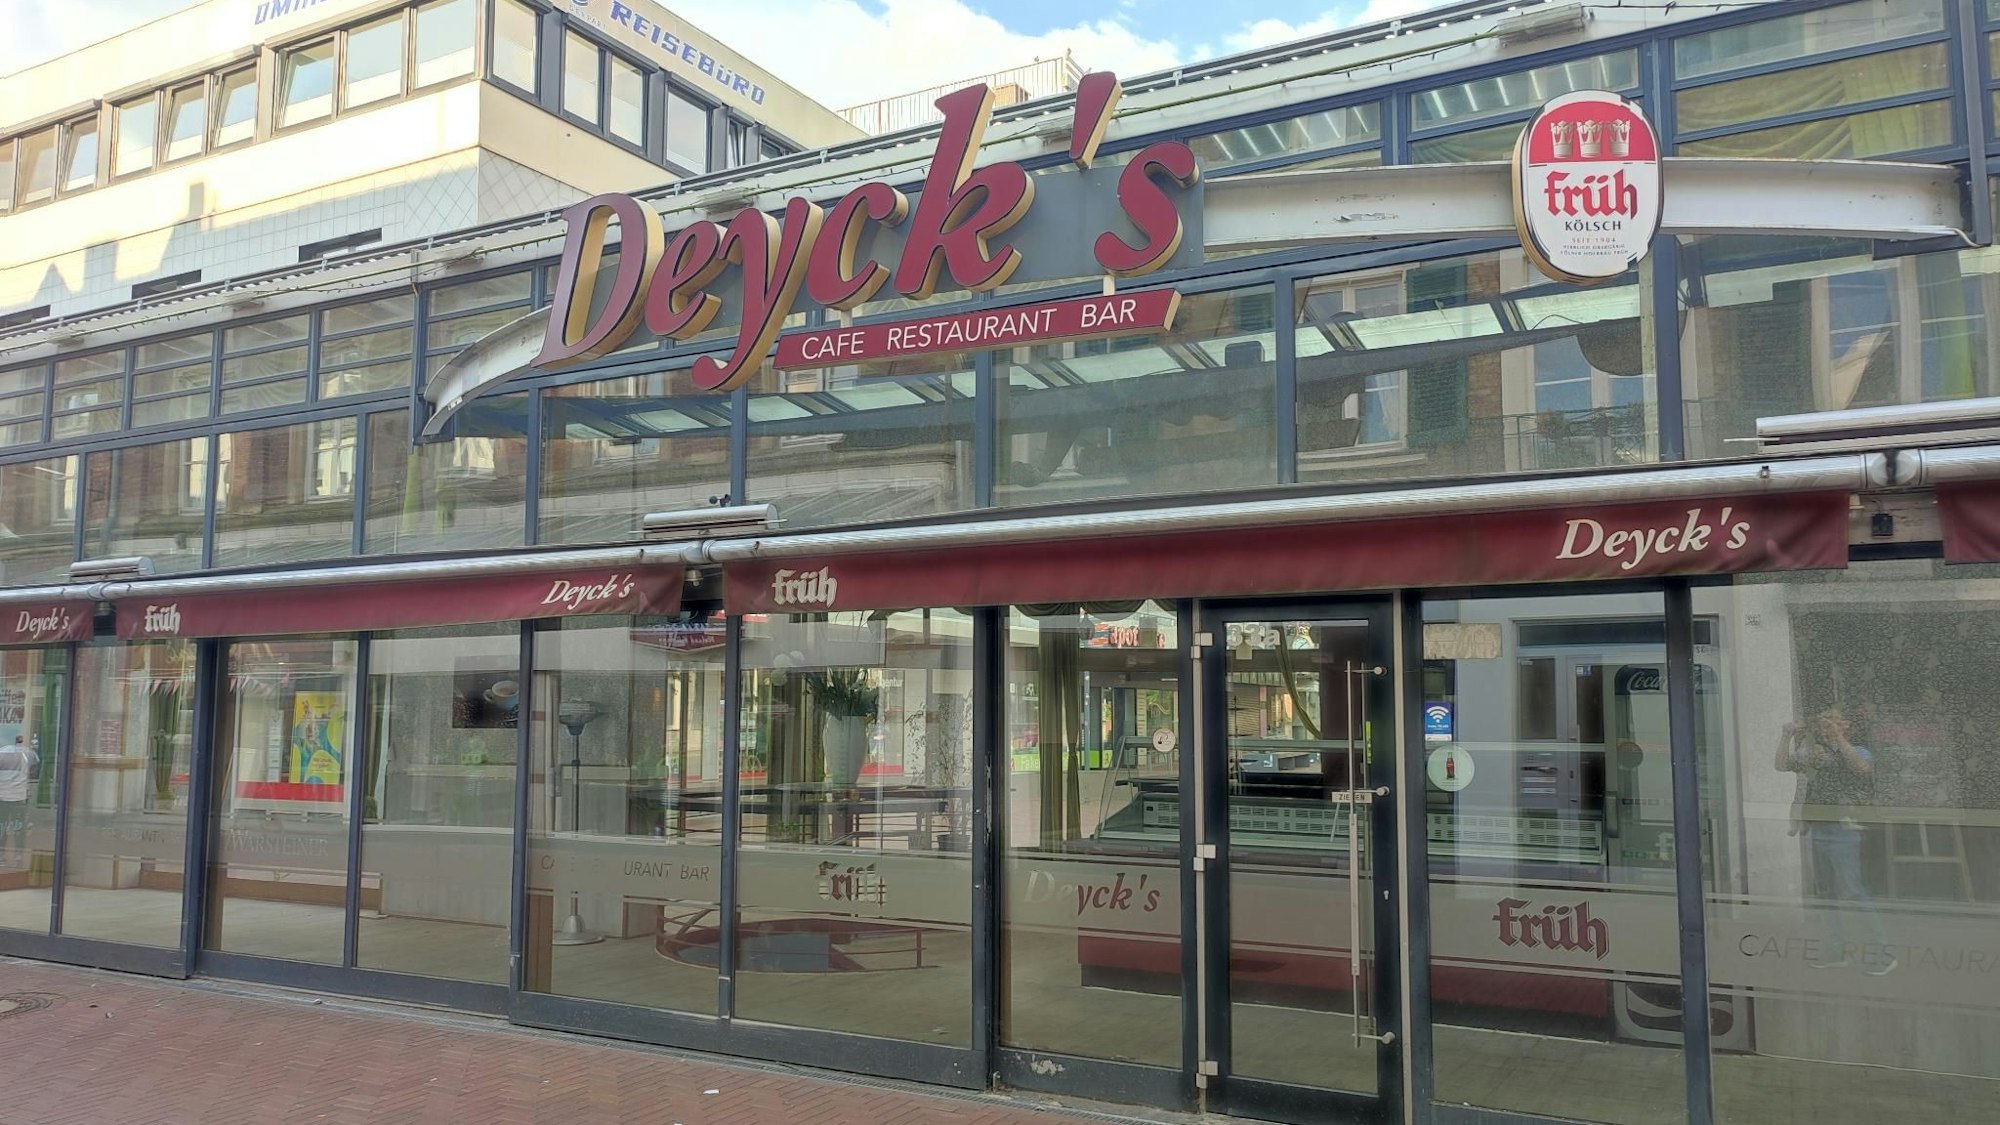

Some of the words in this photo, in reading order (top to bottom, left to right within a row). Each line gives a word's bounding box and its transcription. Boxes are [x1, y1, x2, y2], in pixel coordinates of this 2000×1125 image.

[529, 71, 1199, 391] Deyck's
[1564, 220, 1622, 232] KÖLSCH
[801, 331, 865, 360] CAFE
[887, 308, 1058, 351] RESTAURANT
[1080, 299, 1137, 328] BAR
[1555, 506, 1751, 570] Deyck's
[541, 573, 635, 610] Deyck's
[15, 606, 70, 639] Deyck's
[1338, 793, 1366, 801] ZIEEN
[680, 864, 711, 881] BAR
[1739, 934, 1820, 961] CAFE
